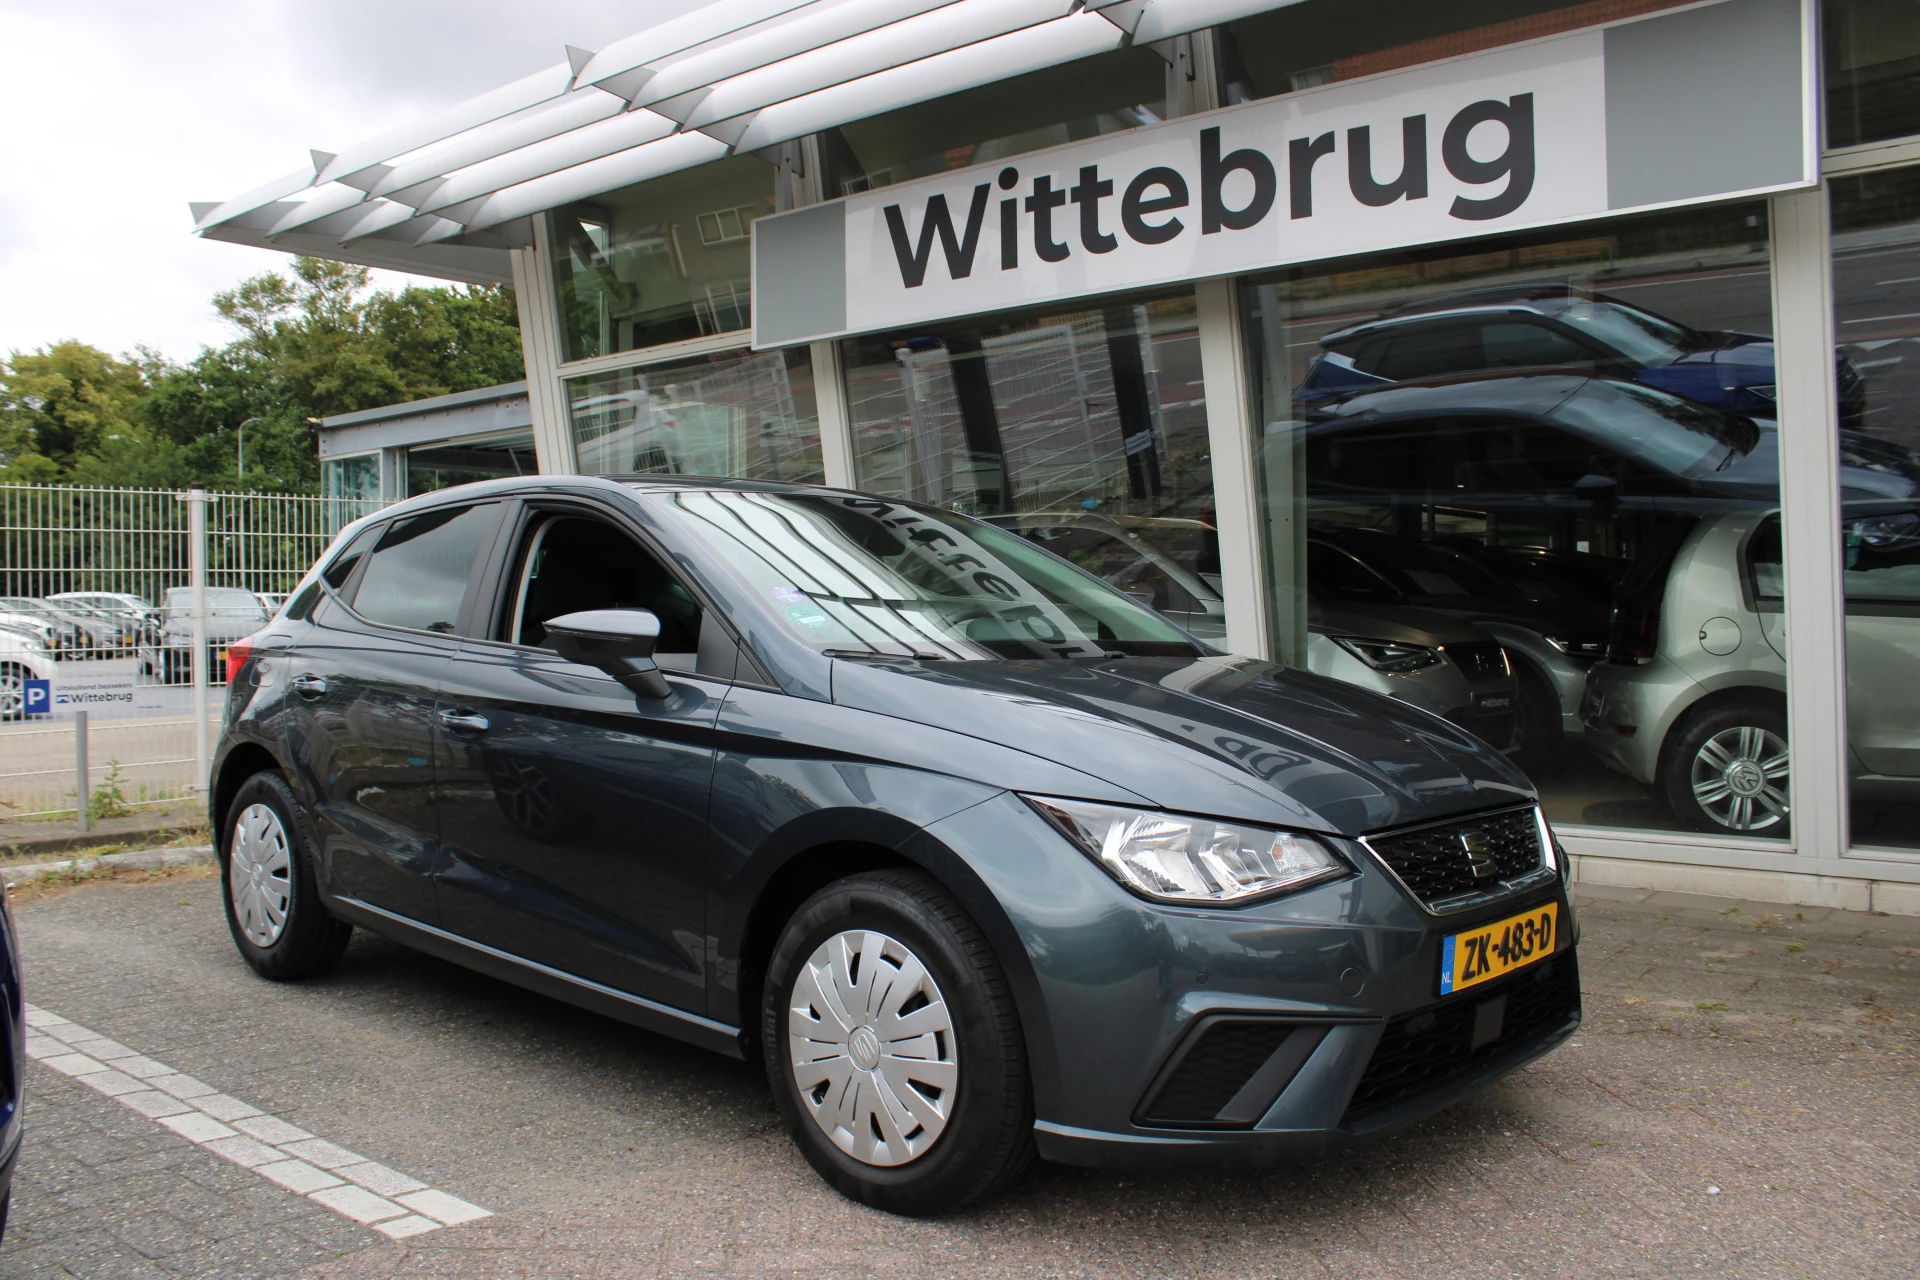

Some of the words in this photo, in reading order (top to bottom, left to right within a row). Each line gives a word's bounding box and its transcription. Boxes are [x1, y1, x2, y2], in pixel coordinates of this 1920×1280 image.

[883, 91, 1537, 289] Wittebrug
[28, 688, 45, 705] P
[71, 692, 133, 703] Wittebrug
[1462, 912, 1551, 981] ZK-483-D
[1442, 971, 1452, 984] NL
